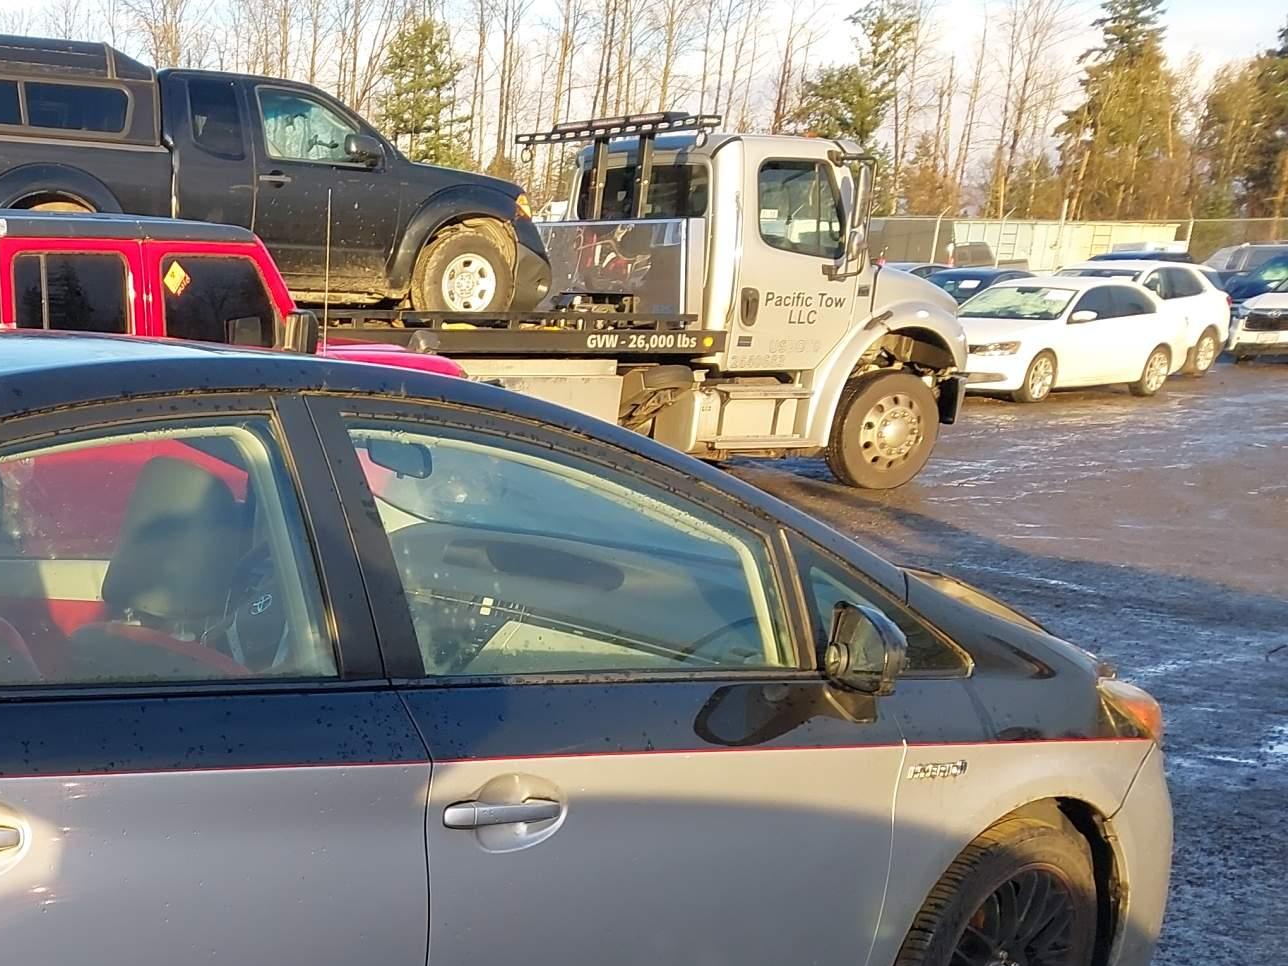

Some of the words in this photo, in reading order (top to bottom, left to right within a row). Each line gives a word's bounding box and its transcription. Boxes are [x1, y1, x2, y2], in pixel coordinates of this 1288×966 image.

[764, 292, 813, 307] Pacific
[817, 293, 846, 308] Tow
[788, 309, 817, 325] LLC
[586, 334, 619, 349] GVW
[627, 334, 675, 351] 26,000
[676, 333, 697, 348] lbs
